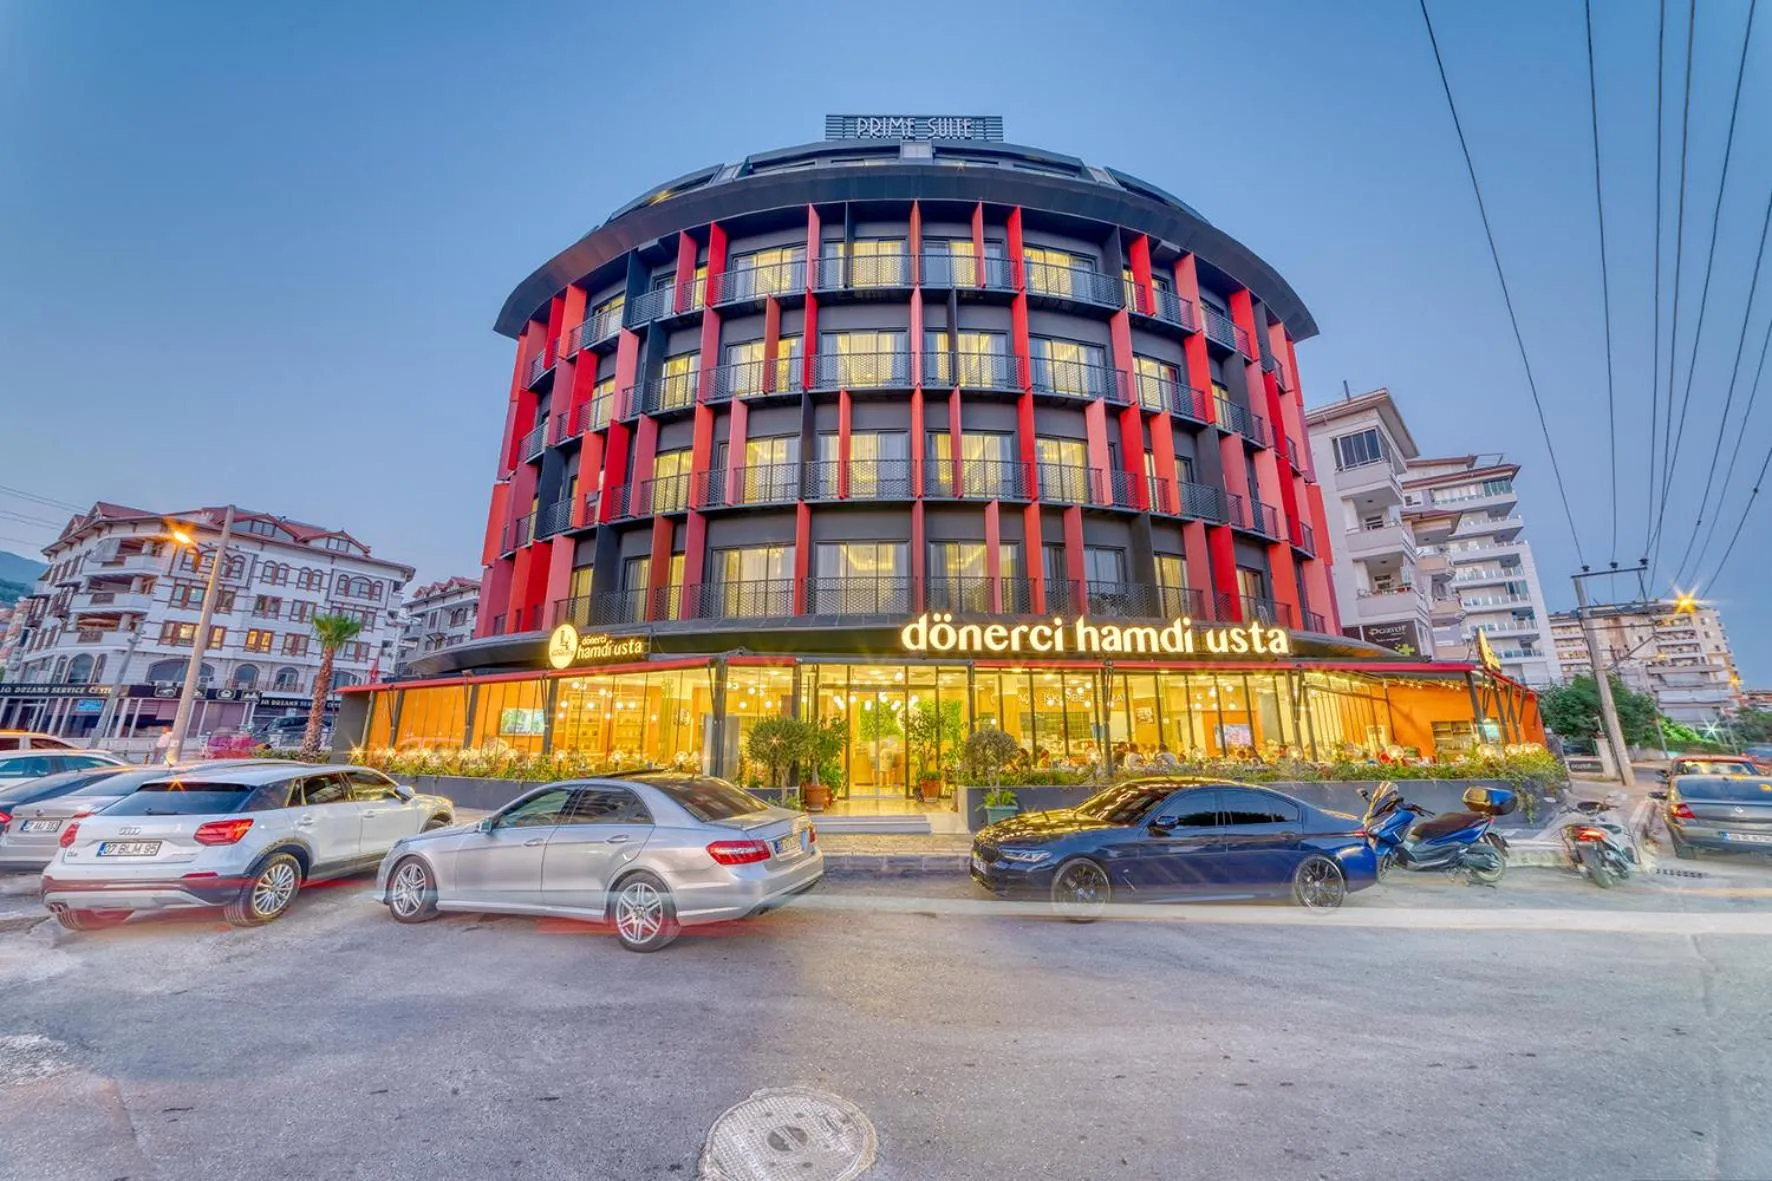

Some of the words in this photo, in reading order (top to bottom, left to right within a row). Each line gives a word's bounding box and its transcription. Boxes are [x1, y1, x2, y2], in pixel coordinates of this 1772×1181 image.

[856, 117, 916, 137] PRIME
[927, 117, 972, 138] SUITE
[581, 633, 608, 646] dönerci
[901, 613, 1064, 652] dönerci
[1076, 615, 1194, 653] hamdi
[1205, 621, 1291, 654] usta
[577, 640, 613, 660] hamdi
[613, 638, 643, 656] usta
[51, 686, 85, 694] SERVICE
